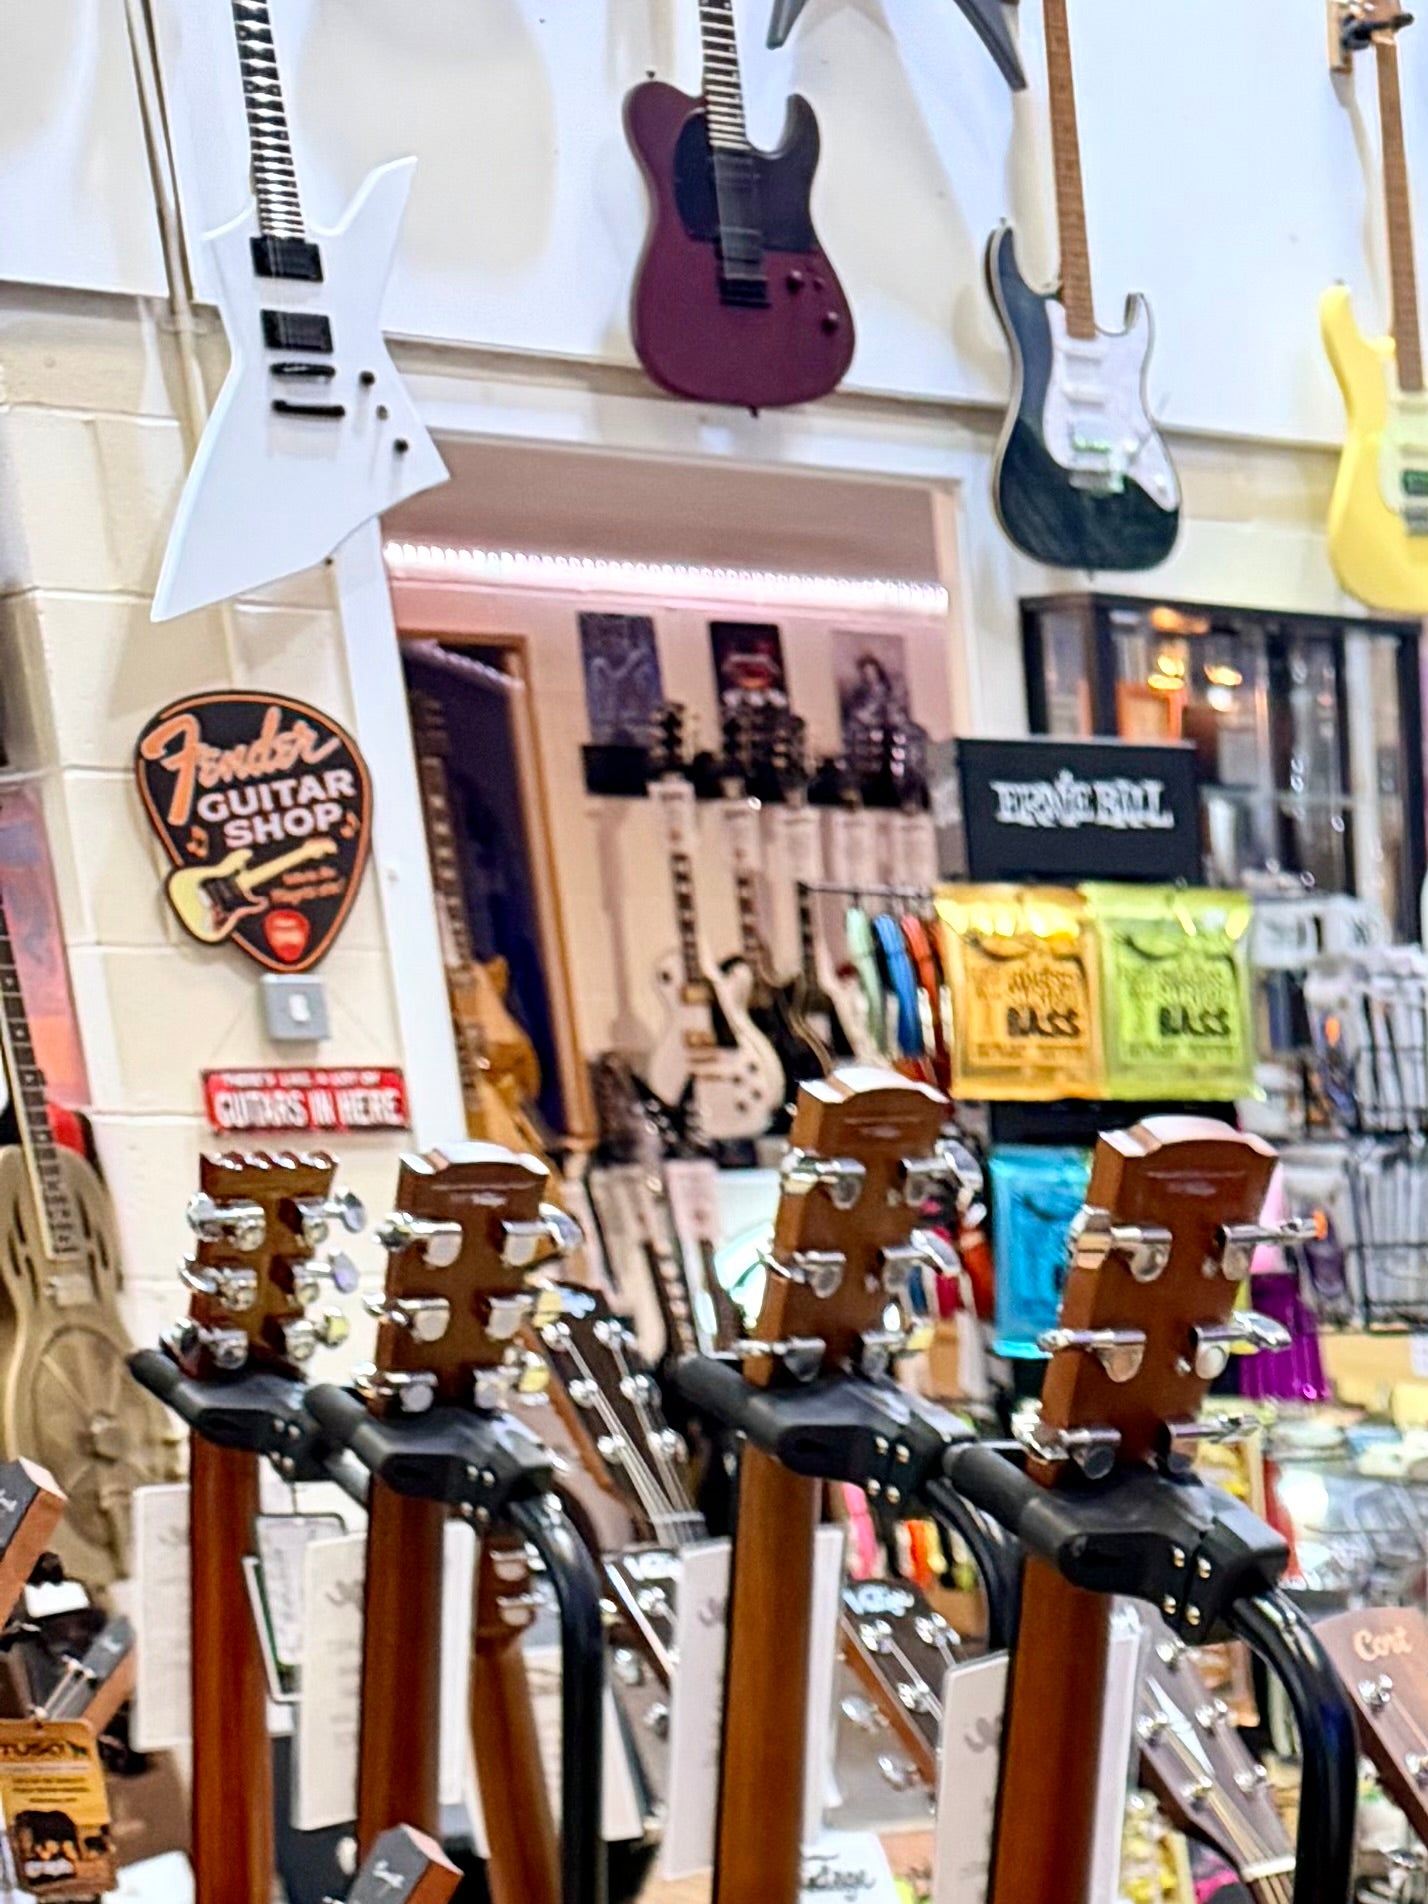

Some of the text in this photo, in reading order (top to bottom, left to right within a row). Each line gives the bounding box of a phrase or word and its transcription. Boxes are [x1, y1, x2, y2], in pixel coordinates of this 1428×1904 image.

[141, 706, 342, 826] Fender
[197, 768, 357, 823] GUITAR
[223, 802, 344, 849] SHOP
[1353, 1626, 1413, 1662] Cort
